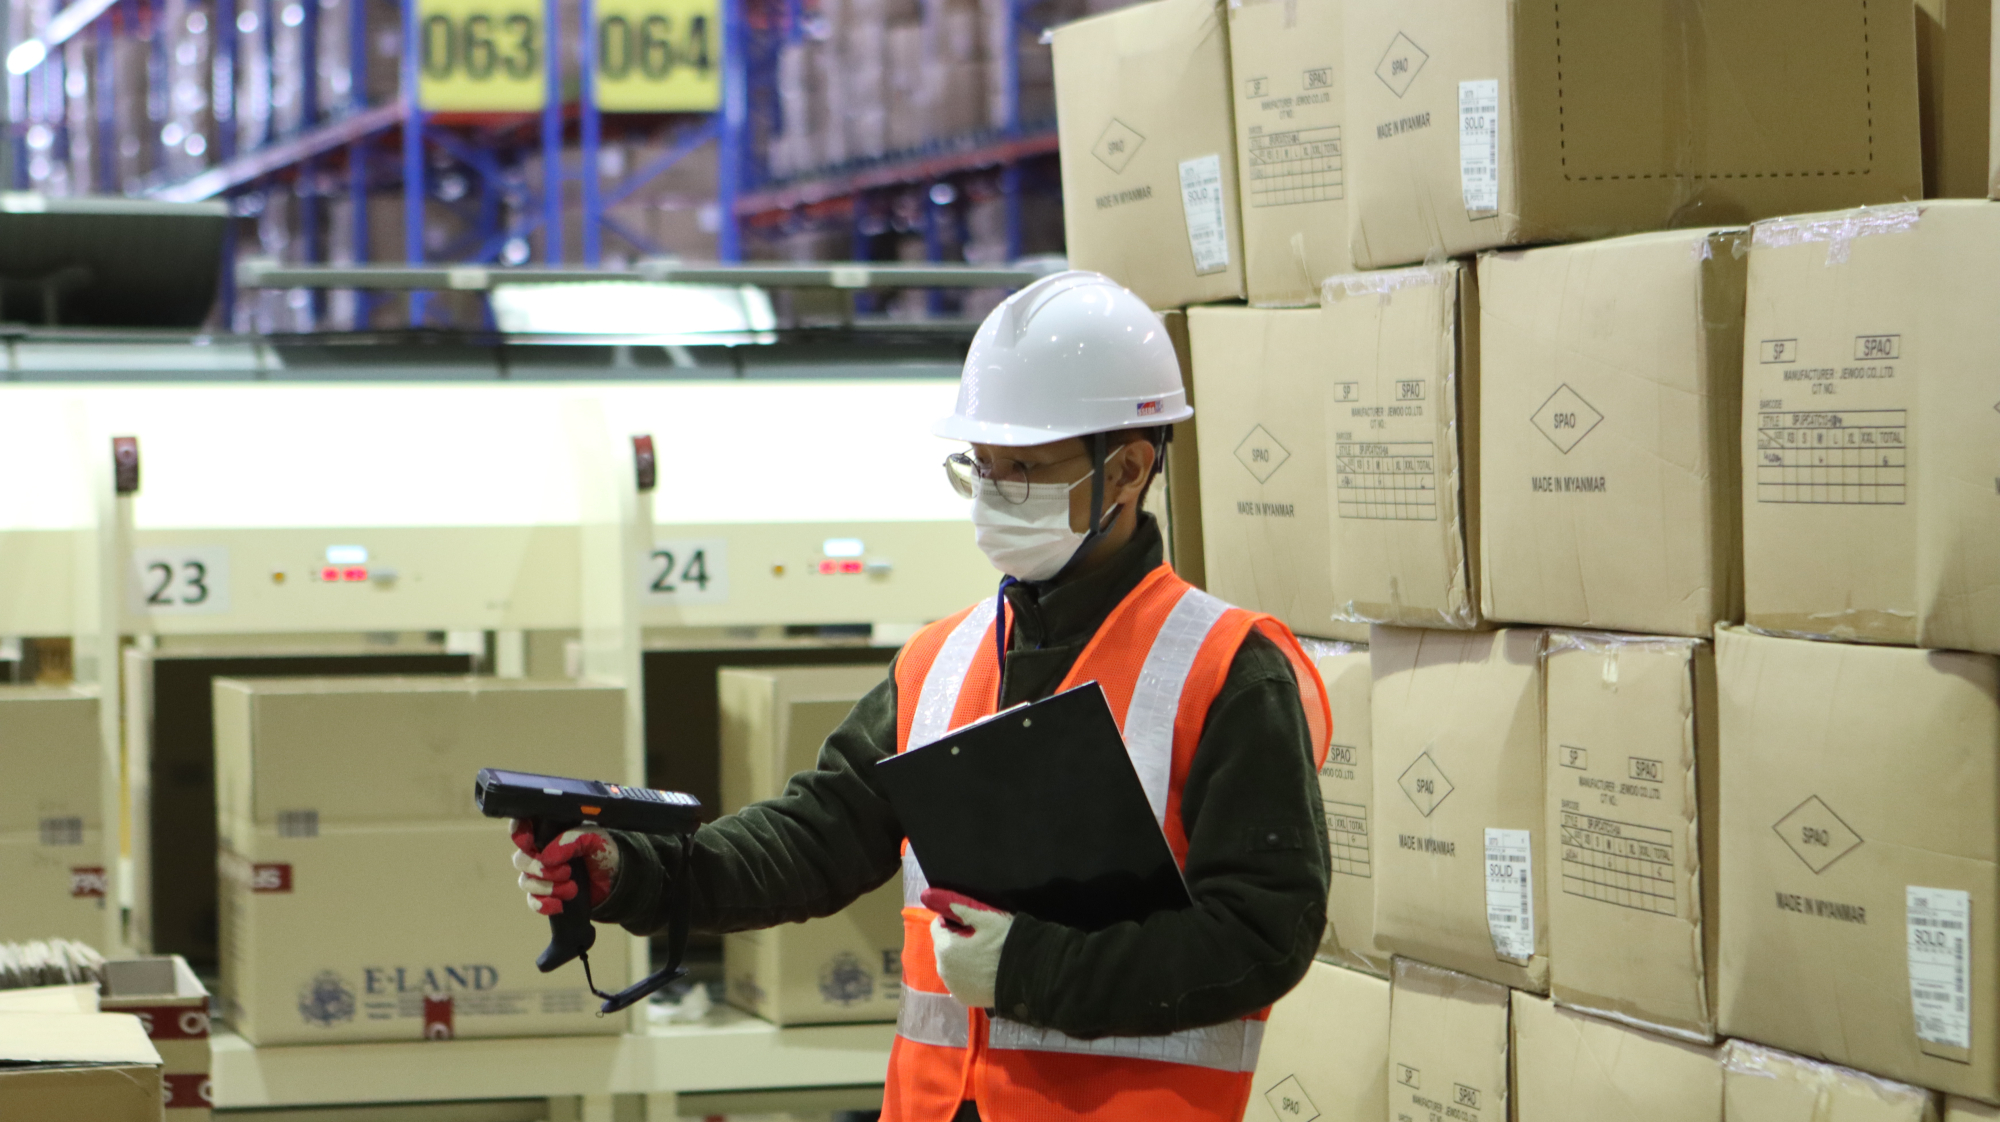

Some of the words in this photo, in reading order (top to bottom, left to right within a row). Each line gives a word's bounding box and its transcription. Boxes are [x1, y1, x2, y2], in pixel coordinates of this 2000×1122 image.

[425, 15, 533, 81] 063
[601, 15, 709, 81] 064
[1391, 58, 1408, 75] SPAO
[1308, 71, 1327, 87] SPAO
[1376, 122, 1393, 139] MADE
[1400, 112, 1431, 132] MYANMAR
[1465, 116, 1484, 130] SOLID
[1096, 193, 1112, 209] MADE
[1120, 185, 1152, 204] MYANMAR
[1188, 188, 1207, 202] SOLID
[1773, 343, 1784, 359] SP
[1864, 339, 1891, 356] SPAO
[1839, 366, 1864, 380] JEWOO
[1343, 385, 1350, 399] SP
[1402, 383, 1420, 398] SPAO
[1387, 406, 1403, 417] JEWOO
[1554, 412, 1576, 429] SPAO
[1762, 415, 1780, 427] STYLE
[1879, 431, 1902, 444] TOTAL
[1252, 448, 1269, 463] SPAO
[1532, 476, 1553, 492] MADE
[1554, 476, 1562, 492] IN
[1563, 476, 1607, 493] MYANMAR
[1237, 501, 1254, 516] MADE
[1254, 503, 1261, 516] IN
[1262, 503, 1295, 518] MYANMAR
[650, 550, 709, 592] 24
[145, 561, 209, 605] 23
[1331, 747, 1350, 762] SPAO
[1636, 760, 1657, 778] SPAO
[1416, 779, 1434, 794] SPAO
[1349, 820, 1364, 832] TOTAL
[1399, 834, 1416, 850] MADE
[1416, 837, 1423, 851] IN
[1424, 838, 1456, 857] MYANMAR
[1802, 827, 1830, 847] SPAO
[1490, 863, 1513, 877] SOLID
[1775, 891, 1803, 913] MADE
[1803, 897, 1814, 916] IN
[1814, 899, 1867, 925] MYANMAR
[1915, 928, 1945, 947] SOLID
[1459, 1087, 1476, 1106] SPAO
[1282, 1097, 1299, 1115] SPAO
